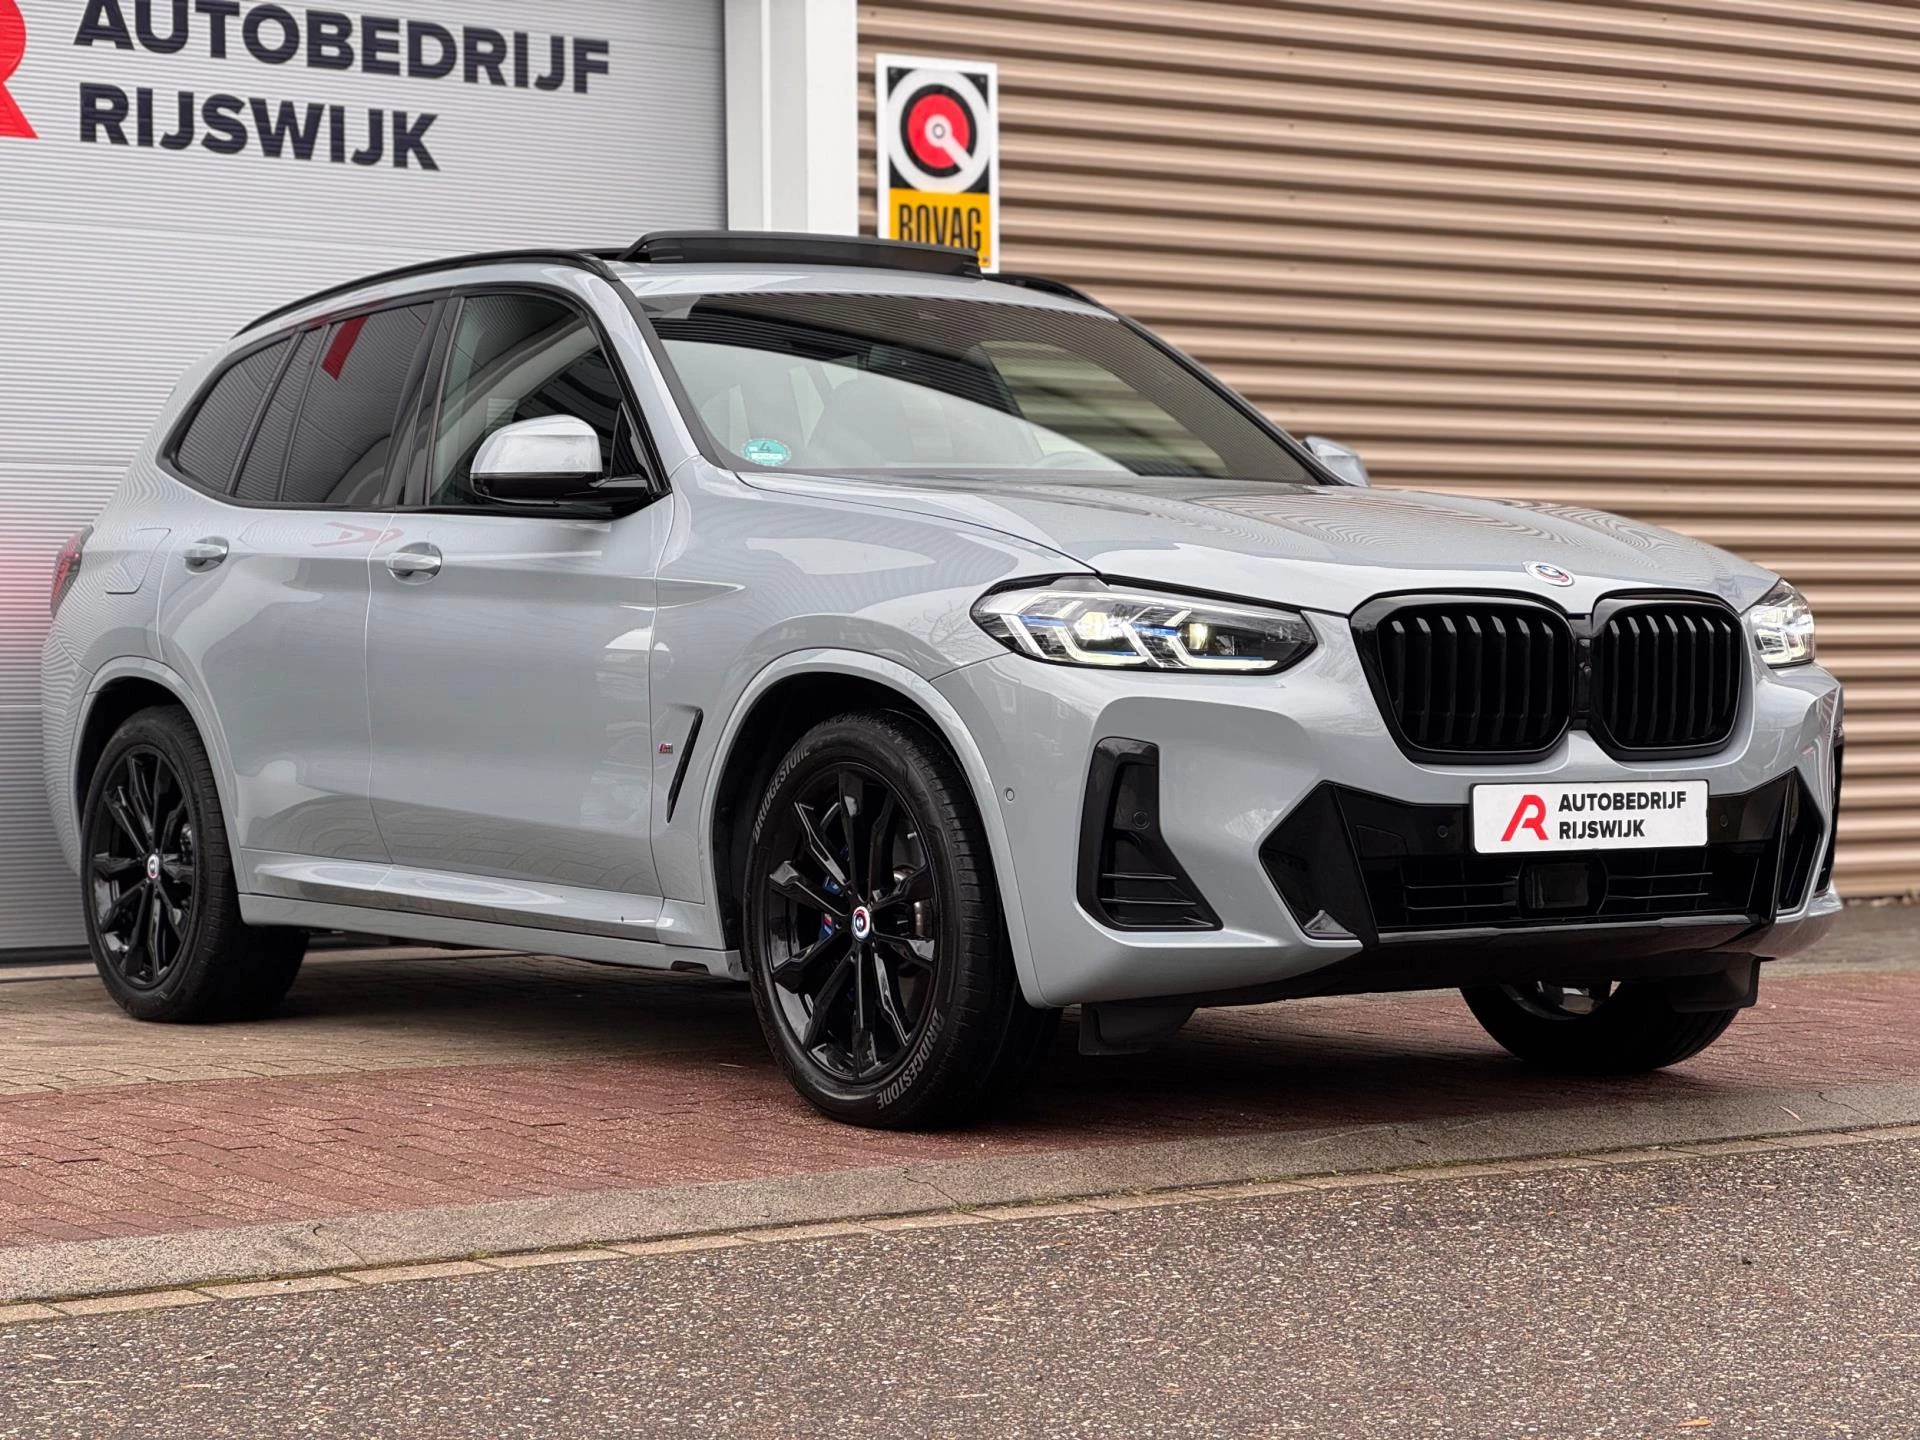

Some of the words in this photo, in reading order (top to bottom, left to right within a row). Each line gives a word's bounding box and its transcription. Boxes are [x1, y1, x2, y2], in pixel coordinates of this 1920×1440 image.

[74, 0, 610, 95] AUTOBEDRIJF
[79, 82, 440, 171] RIJSWIJK
[898, 203, 981, 250] BOVAG
[1558, 791, 1687, 812] AUTOBEDRIJF
[1558, 819, 1645, 840] RIJSWIJK
[876, 1007, 945, 1110] BRIDGESTONE
